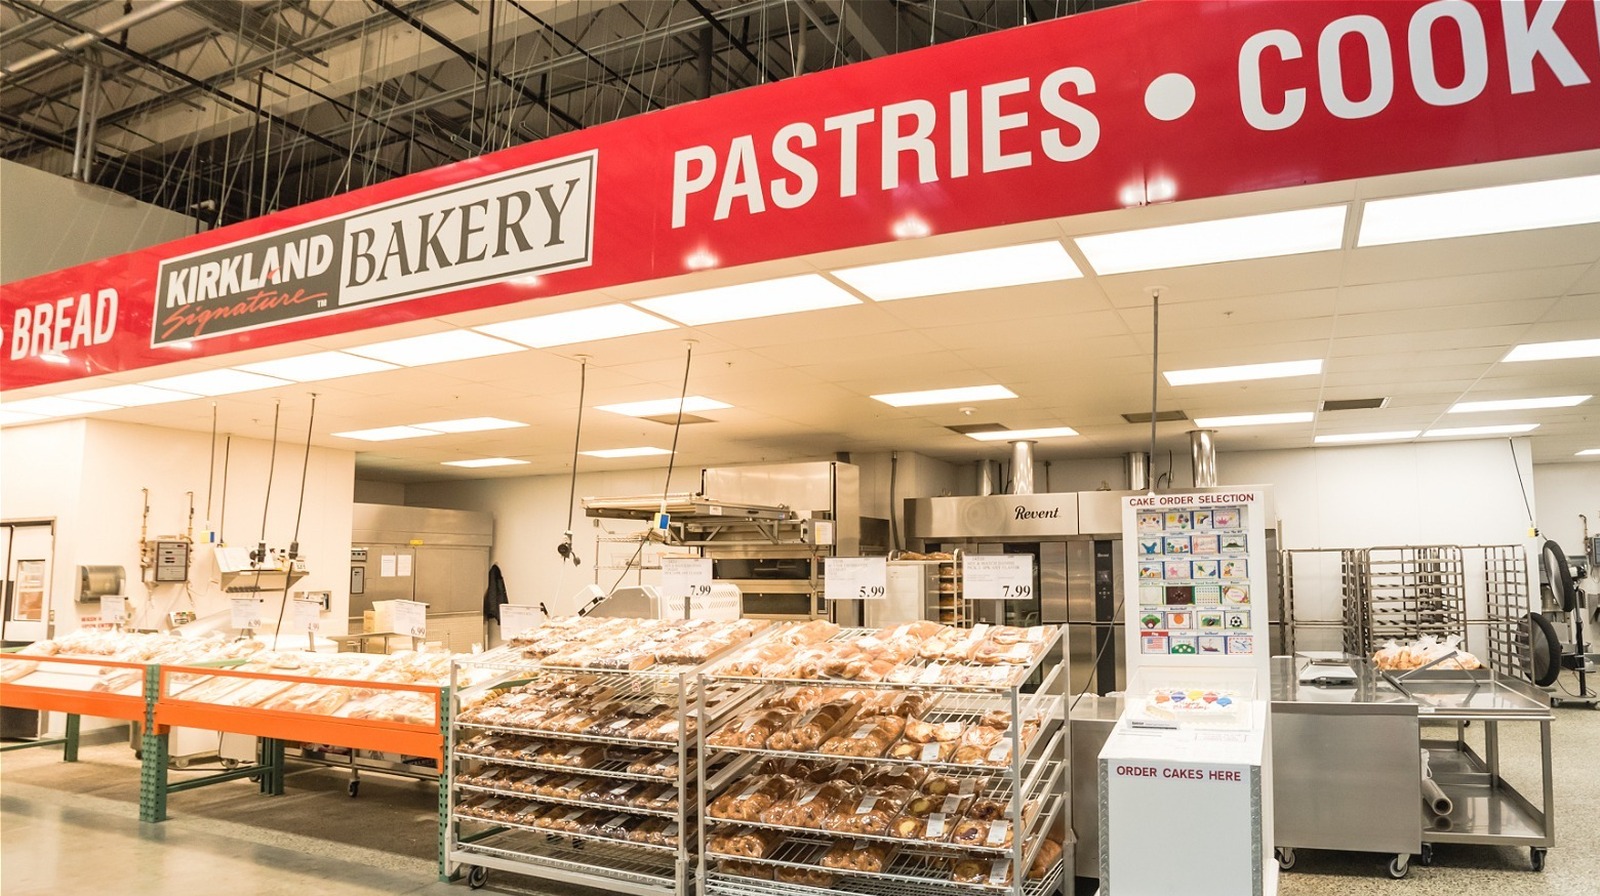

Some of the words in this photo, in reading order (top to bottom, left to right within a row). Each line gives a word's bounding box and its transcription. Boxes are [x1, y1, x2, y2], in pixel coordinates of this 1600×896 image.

[671, 66, 1101, 229] PASTRIES
[1238, 0, 1600, 131] COOK
[345, 178, 580, 288] BAKERY
[166, 234, 334, 308] KIRKLAND
[161, 288, 328, 339] Signature
[11, 288, 119, 361] BREAD
[1129, 497, 1155, 507] CAKE
[1159, 495, 1194, 505] ORDER
[1198, 493, 1254, 504] SELECTION
[1015, 505, 1059, 520] Revent
[690, 584, 711, 596] 7.99
[859, 586, 885, 598] 5.99
[1003, 585, 1031, 598] 7.99
[410, 625, 426, 636] 6.99
[1116, 765, 1157, 777] ORDER
[1162, 768, 1204, 780] CAKES
[1209, 770, 1242, 781] HERE
